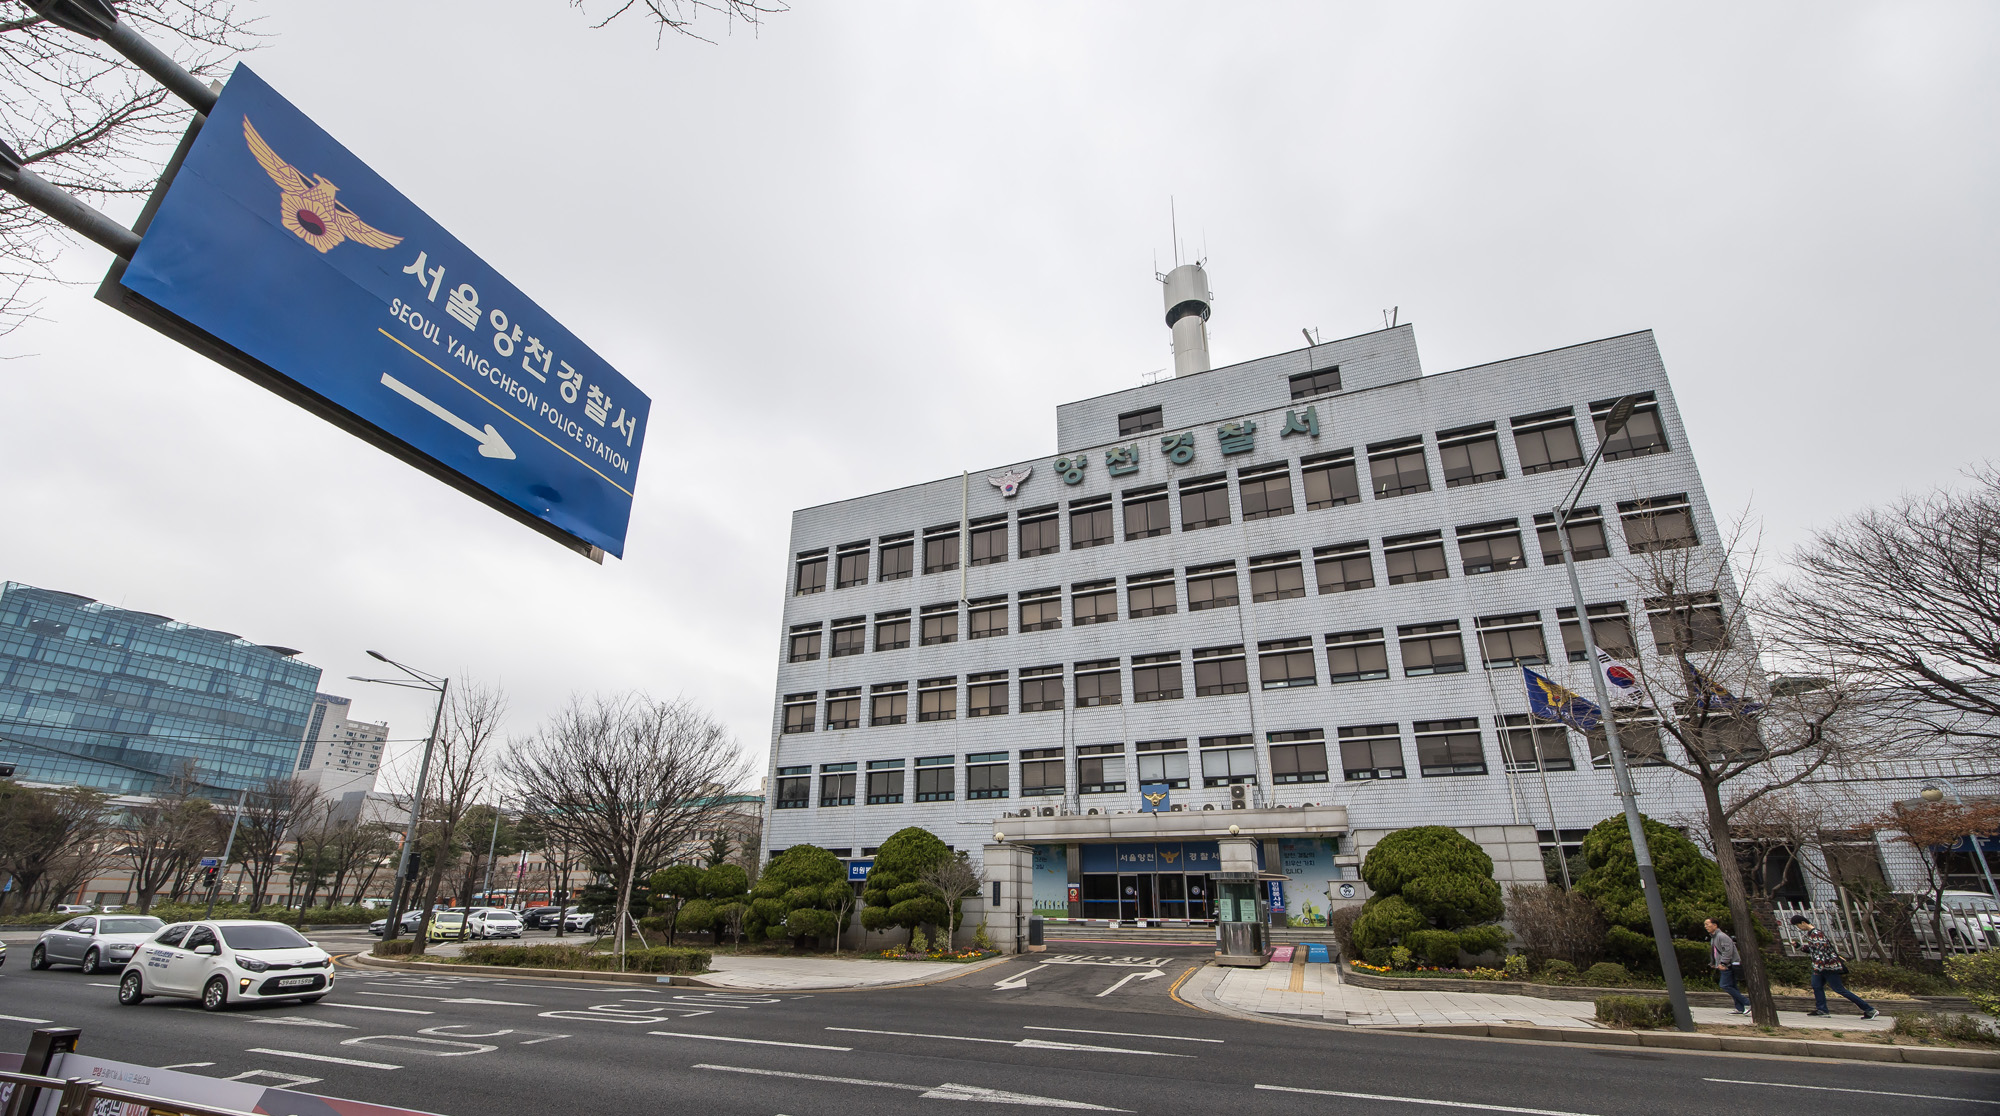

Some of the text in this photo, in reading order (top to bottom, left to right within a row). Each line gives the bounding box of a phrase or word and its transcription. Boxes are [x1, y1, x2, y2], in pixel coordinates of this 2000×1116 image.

[389, 298, 630, 474] SEOUL YANGCHEON POLICE STATION
